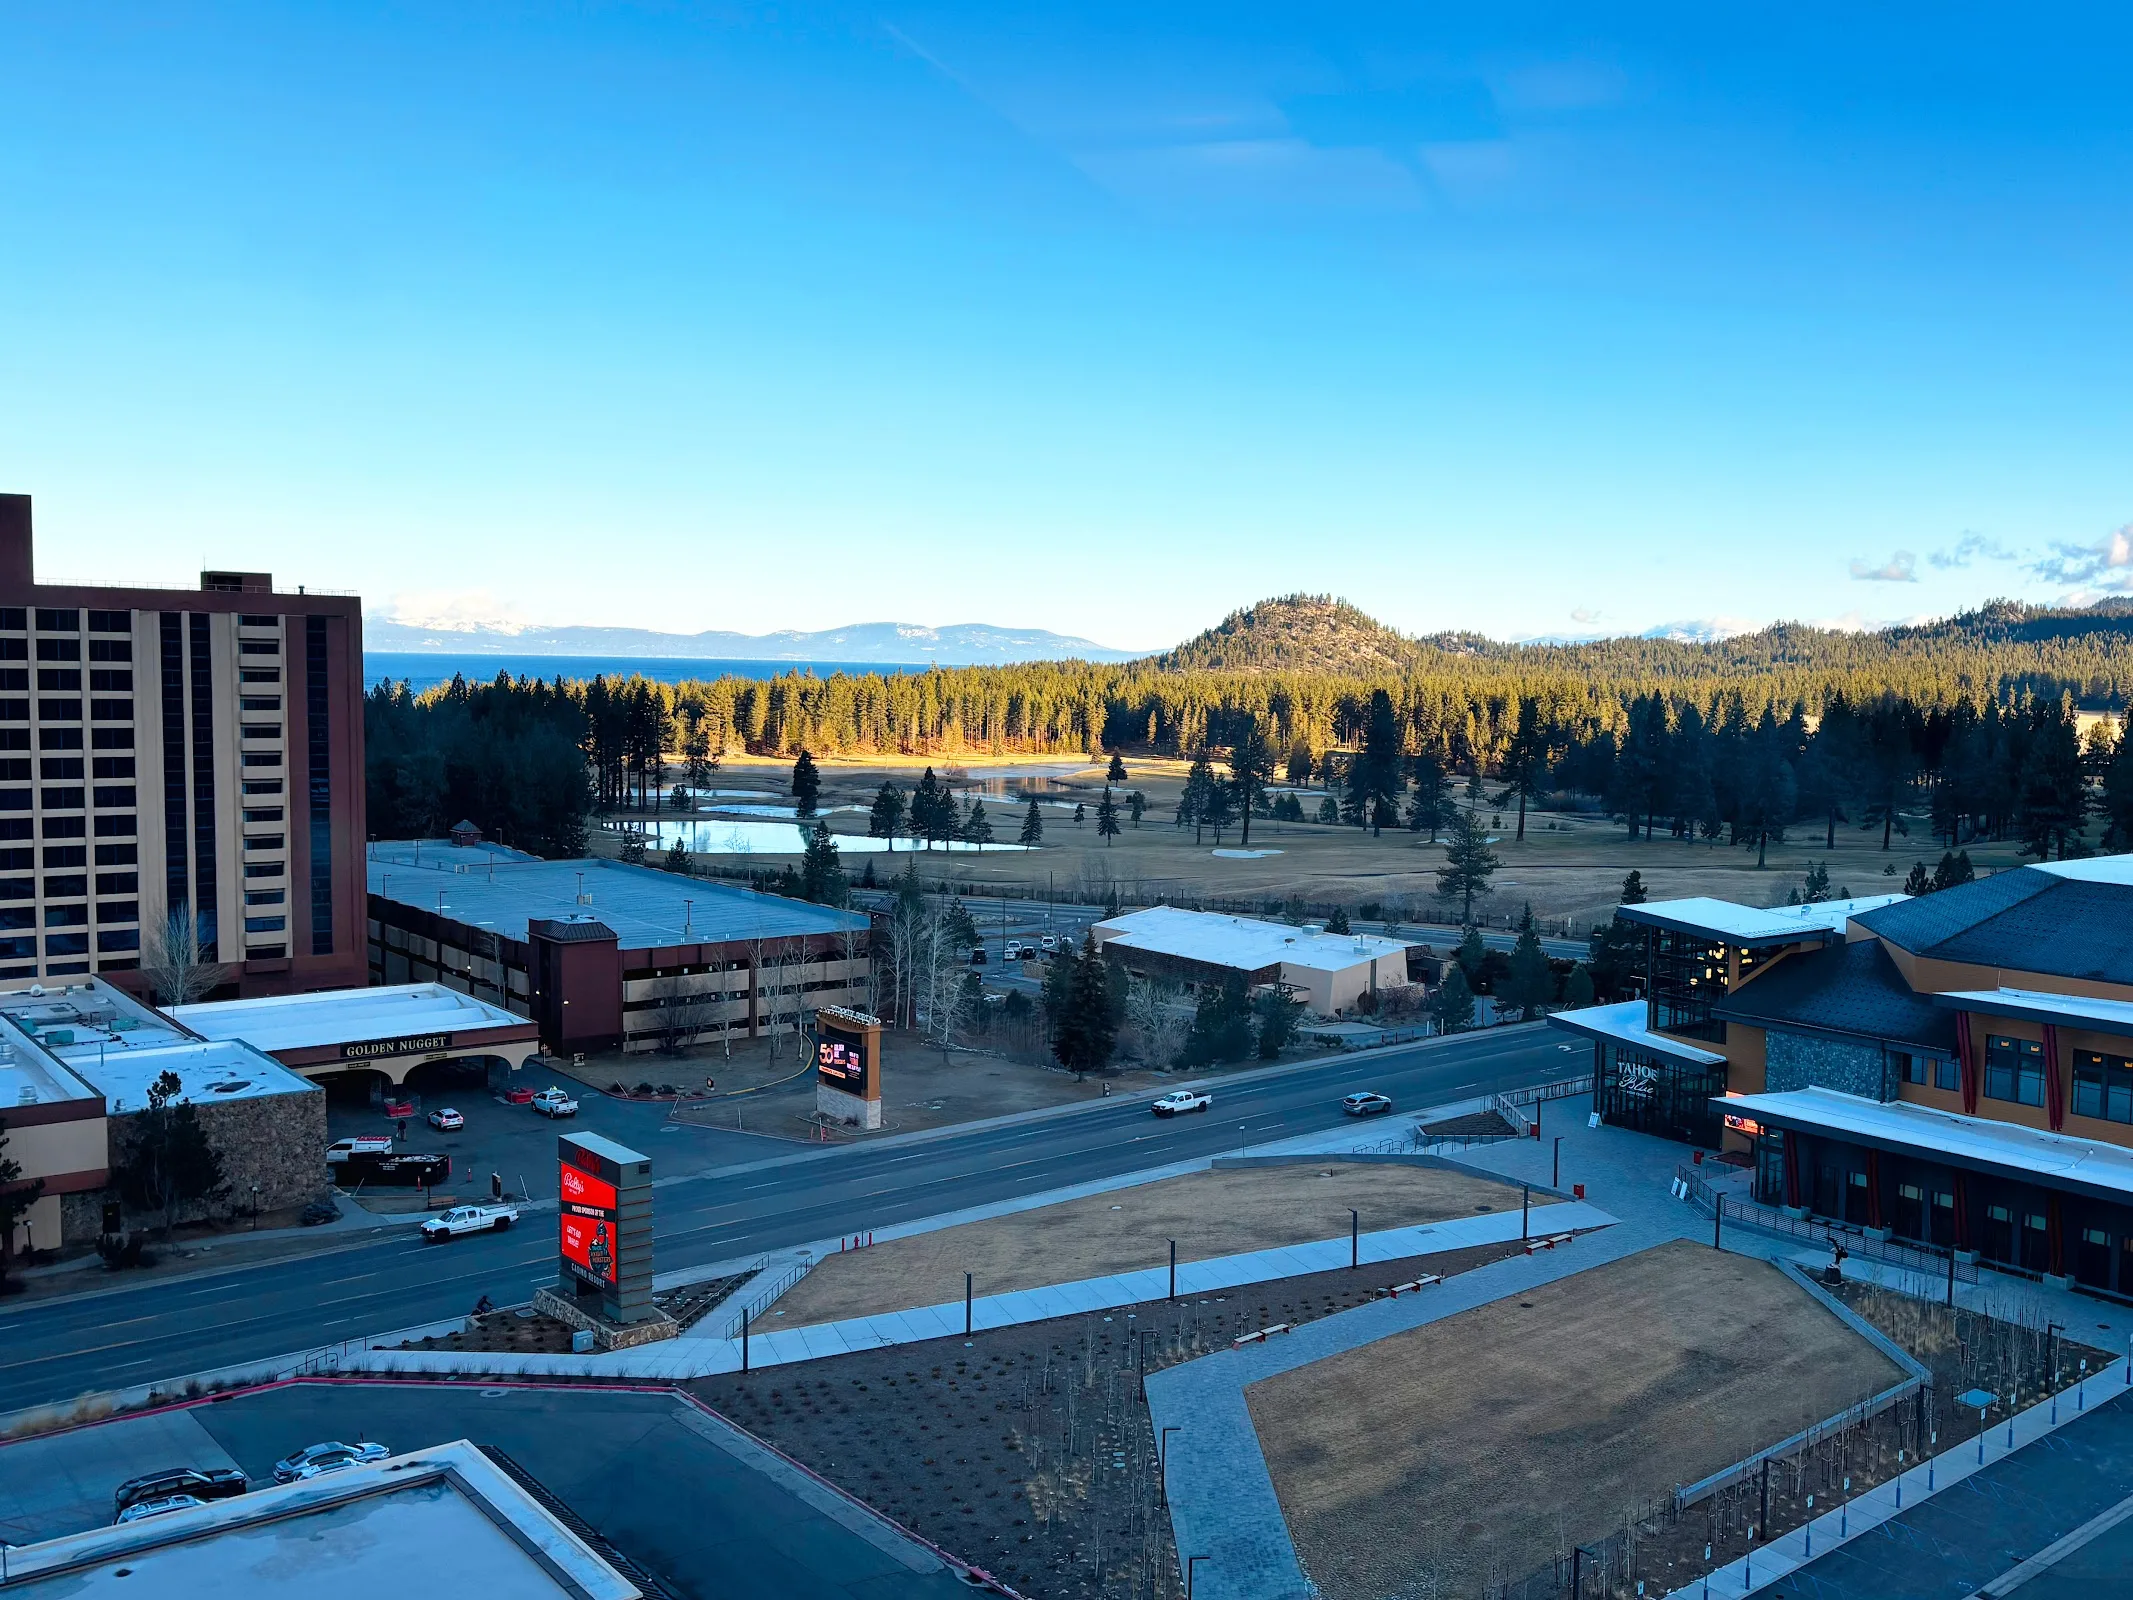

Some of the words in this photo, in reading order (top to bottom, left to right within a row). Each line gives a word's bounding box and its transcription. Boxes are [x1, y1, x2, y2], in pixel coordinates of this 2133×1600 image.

[346, 1042, 394, 1056] GOLDEN
[400, 1036, 446, 1050] NUGGET
[1617, 1062, 1658, 1082] TAHOE
[1618, 1074, 1654, 1093] Blue
[564, 1172, 585, 1195] Bally's
[571, 1262, 588, 1279] CASINO
